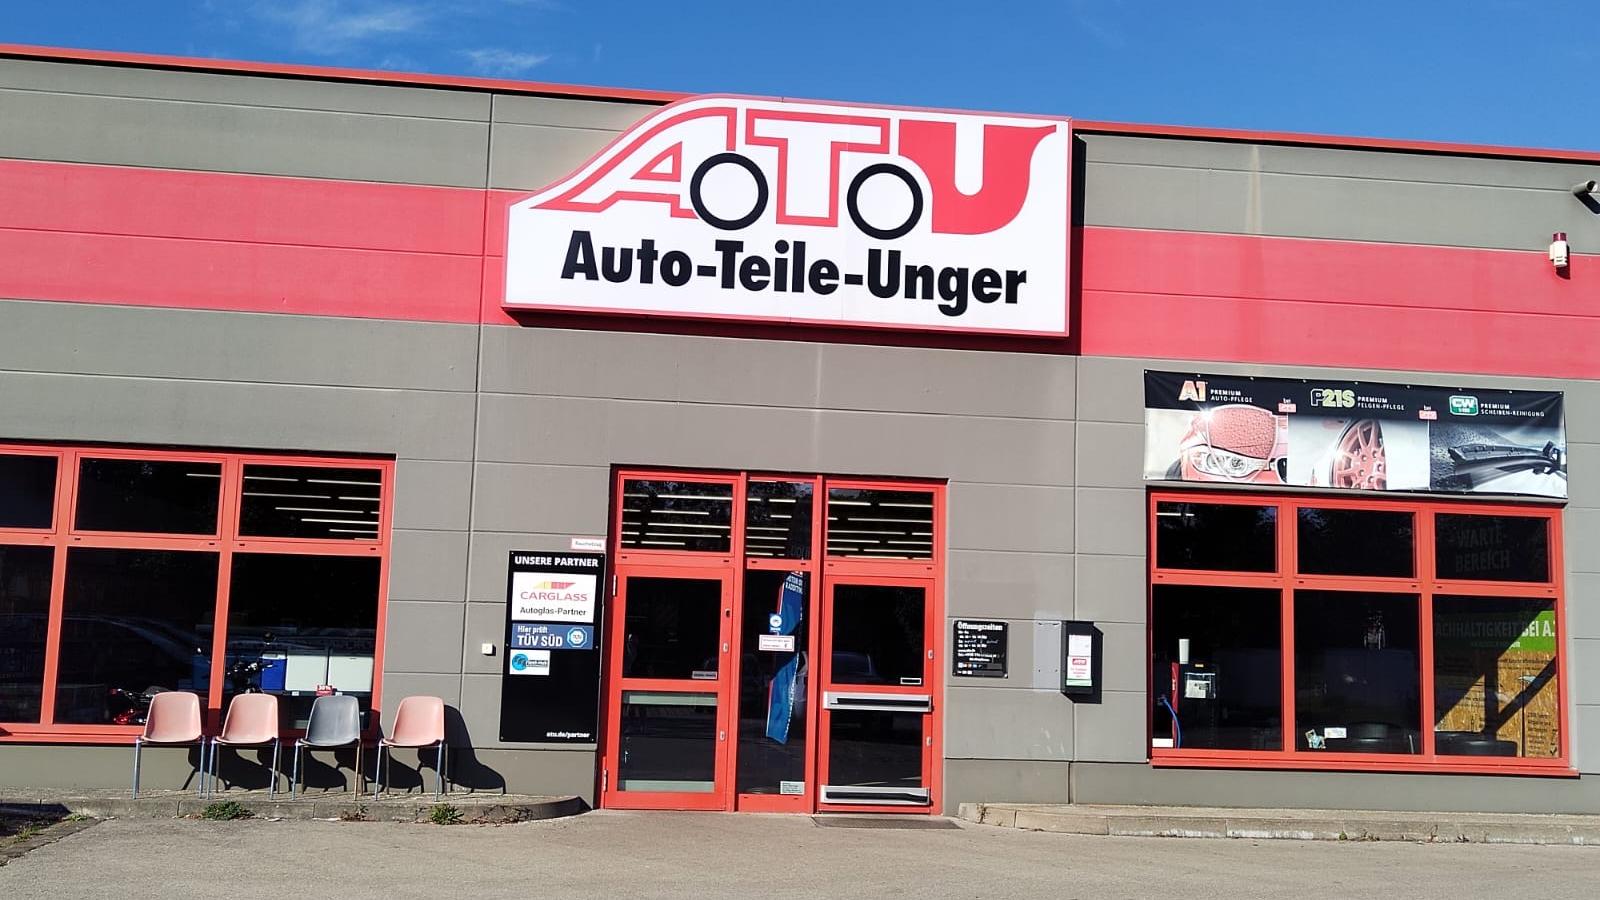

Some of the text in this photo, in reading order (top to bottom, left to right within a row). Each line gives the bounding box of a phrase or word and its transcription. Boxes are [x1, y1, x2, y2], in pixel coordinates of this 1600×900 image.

[561, 230, 1027, 317] Auto-Teile-Unger
[1178, 380, 1206, 402] A1
[1210, 395, 1253, 403] AUTO-PFLEGE
[1310, 388, 1355, 408] P21S
[1451, 398, 1475, 408] CW
[1357, 402, 1405, 411] FELGEN-PFLEGE
[1480, 409, 1545, 417] SCHEIBEN-REINIGUNG
[514, 556, 599, 568] UNSERE PARTNER
[520, 591, 588, 602] CARGLASS
[520, 606, 587, 617] Autoglas-Partner
[517, 625, 548, 635] Hier prüft
[1521, 620, 1540, 637] BEI
[517, 633, 563, 647] TÜV SÜD
